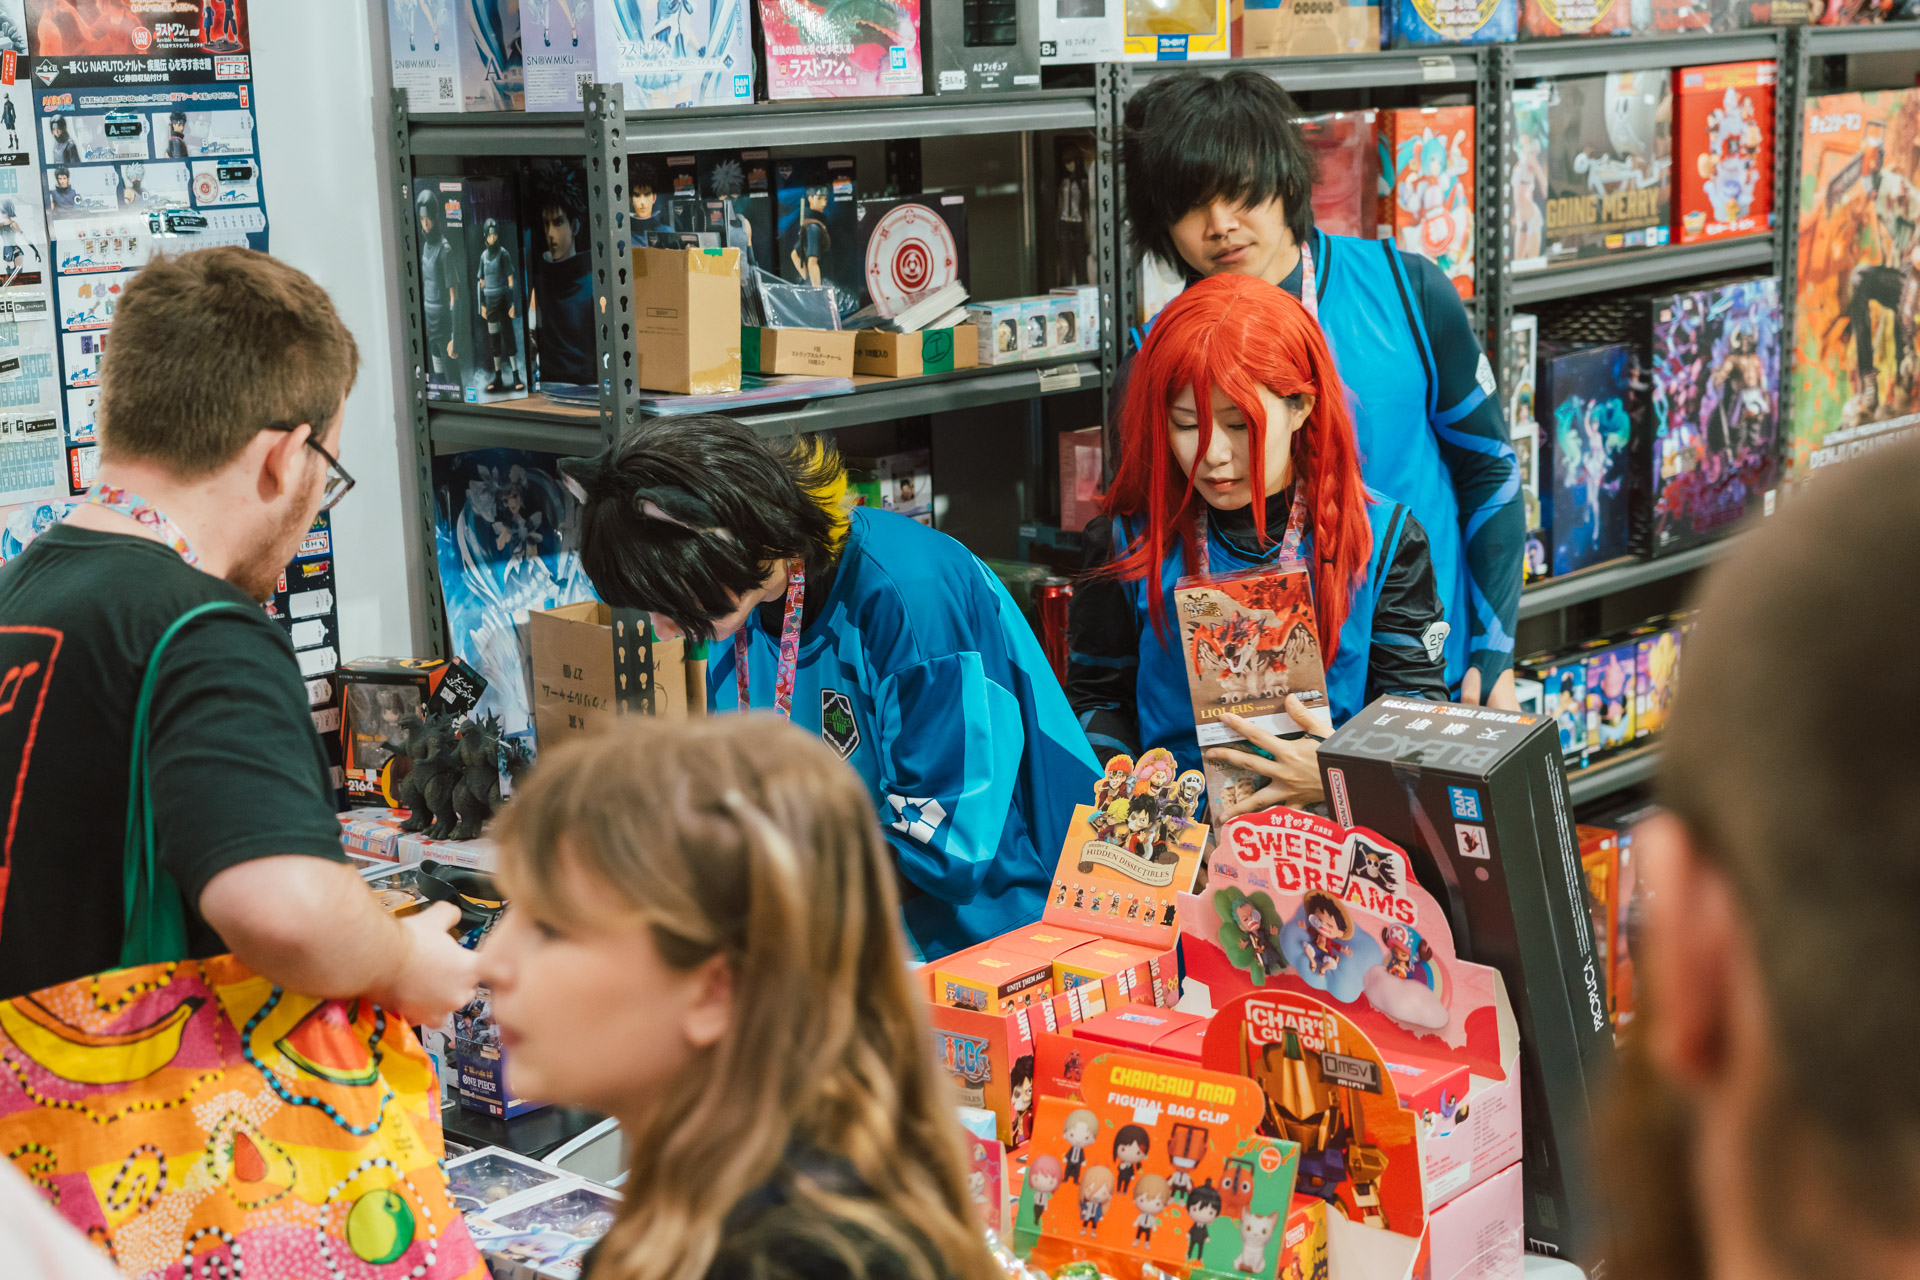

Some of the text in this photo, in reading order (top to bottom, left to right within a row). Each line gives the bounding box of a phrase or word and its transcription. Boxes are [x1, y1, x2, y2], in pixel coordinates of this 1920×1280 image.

[1546, 188, 1660, 228] GOING MERRY
[1331, 728, 1500, 769] BLEACH
[348, 780, 375, 792] 2164
[1332, 773, 1344, 807] NAMCO
[1453, 788, 1468, 816] BAN
[1464, 796, 1478, 818] DAI
[1086, 848, 1170, 878] HIDDEN DISSECTIBLES
[1232, 826, 1342, 871] SWEET
[1274, 857, 1416, 925] DREAMS
[1006, 981, 1022, 993] UNITE
[1022, 976, 1036, 988] THEM
[1116, 970, 1128, 996] LAW
[1126, 967, 1137, 989] KID
[1150, 957, 1165, 1008] BIG MOM
[1583, 955, 1604, 1032] PROPLICA
[1042, 998, 1057, 1032] ZORO
[1066, 989, 1081, 1023] SANJI
[1016, 1009, 1032, 1042] LUFFY
[1253, 1007, 1334, 1041] CHAR'S
[1261, 1027, 1327, 1053] CUTOM
[477, 1078, 497, 1092] PIECE
[1110, 1066, 1194, 1098] CHAINSAW
[1195, 1081, 1237, 1106] MAN
[1107, 1091, 1230, 1125] FIGURAL BAG CLIP
